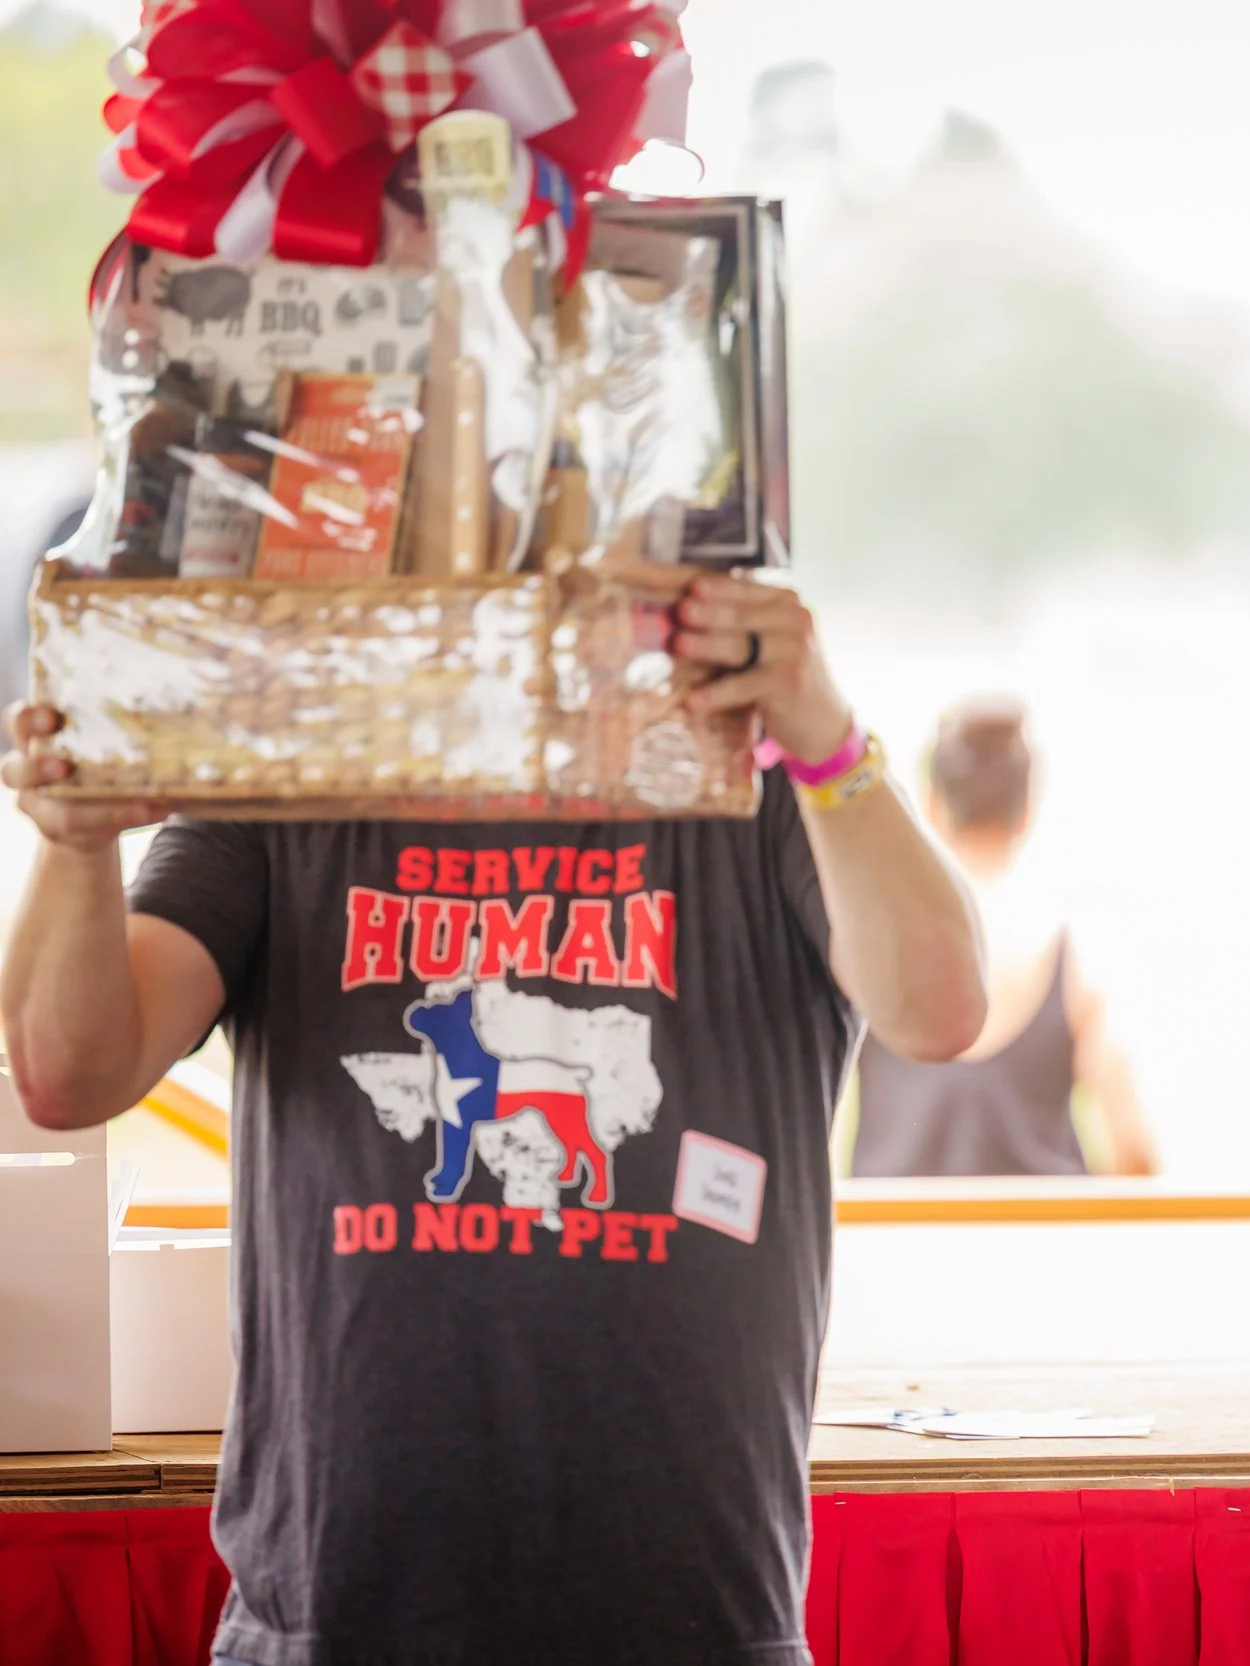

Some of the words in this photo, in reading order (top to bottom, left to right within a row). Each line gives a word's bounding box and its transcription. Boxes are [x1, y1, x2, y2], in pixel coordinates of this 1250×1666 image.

[259, 301, 321, 336] BBQ
[396, 844, 647, 895] SERVICE
[342, 886, 677, 1000] HUMAN
[334, 1203, 398, 1255] DO
[411, 1203, 542, 1255] NOT
[558, 1207, 678, 1263] PET
